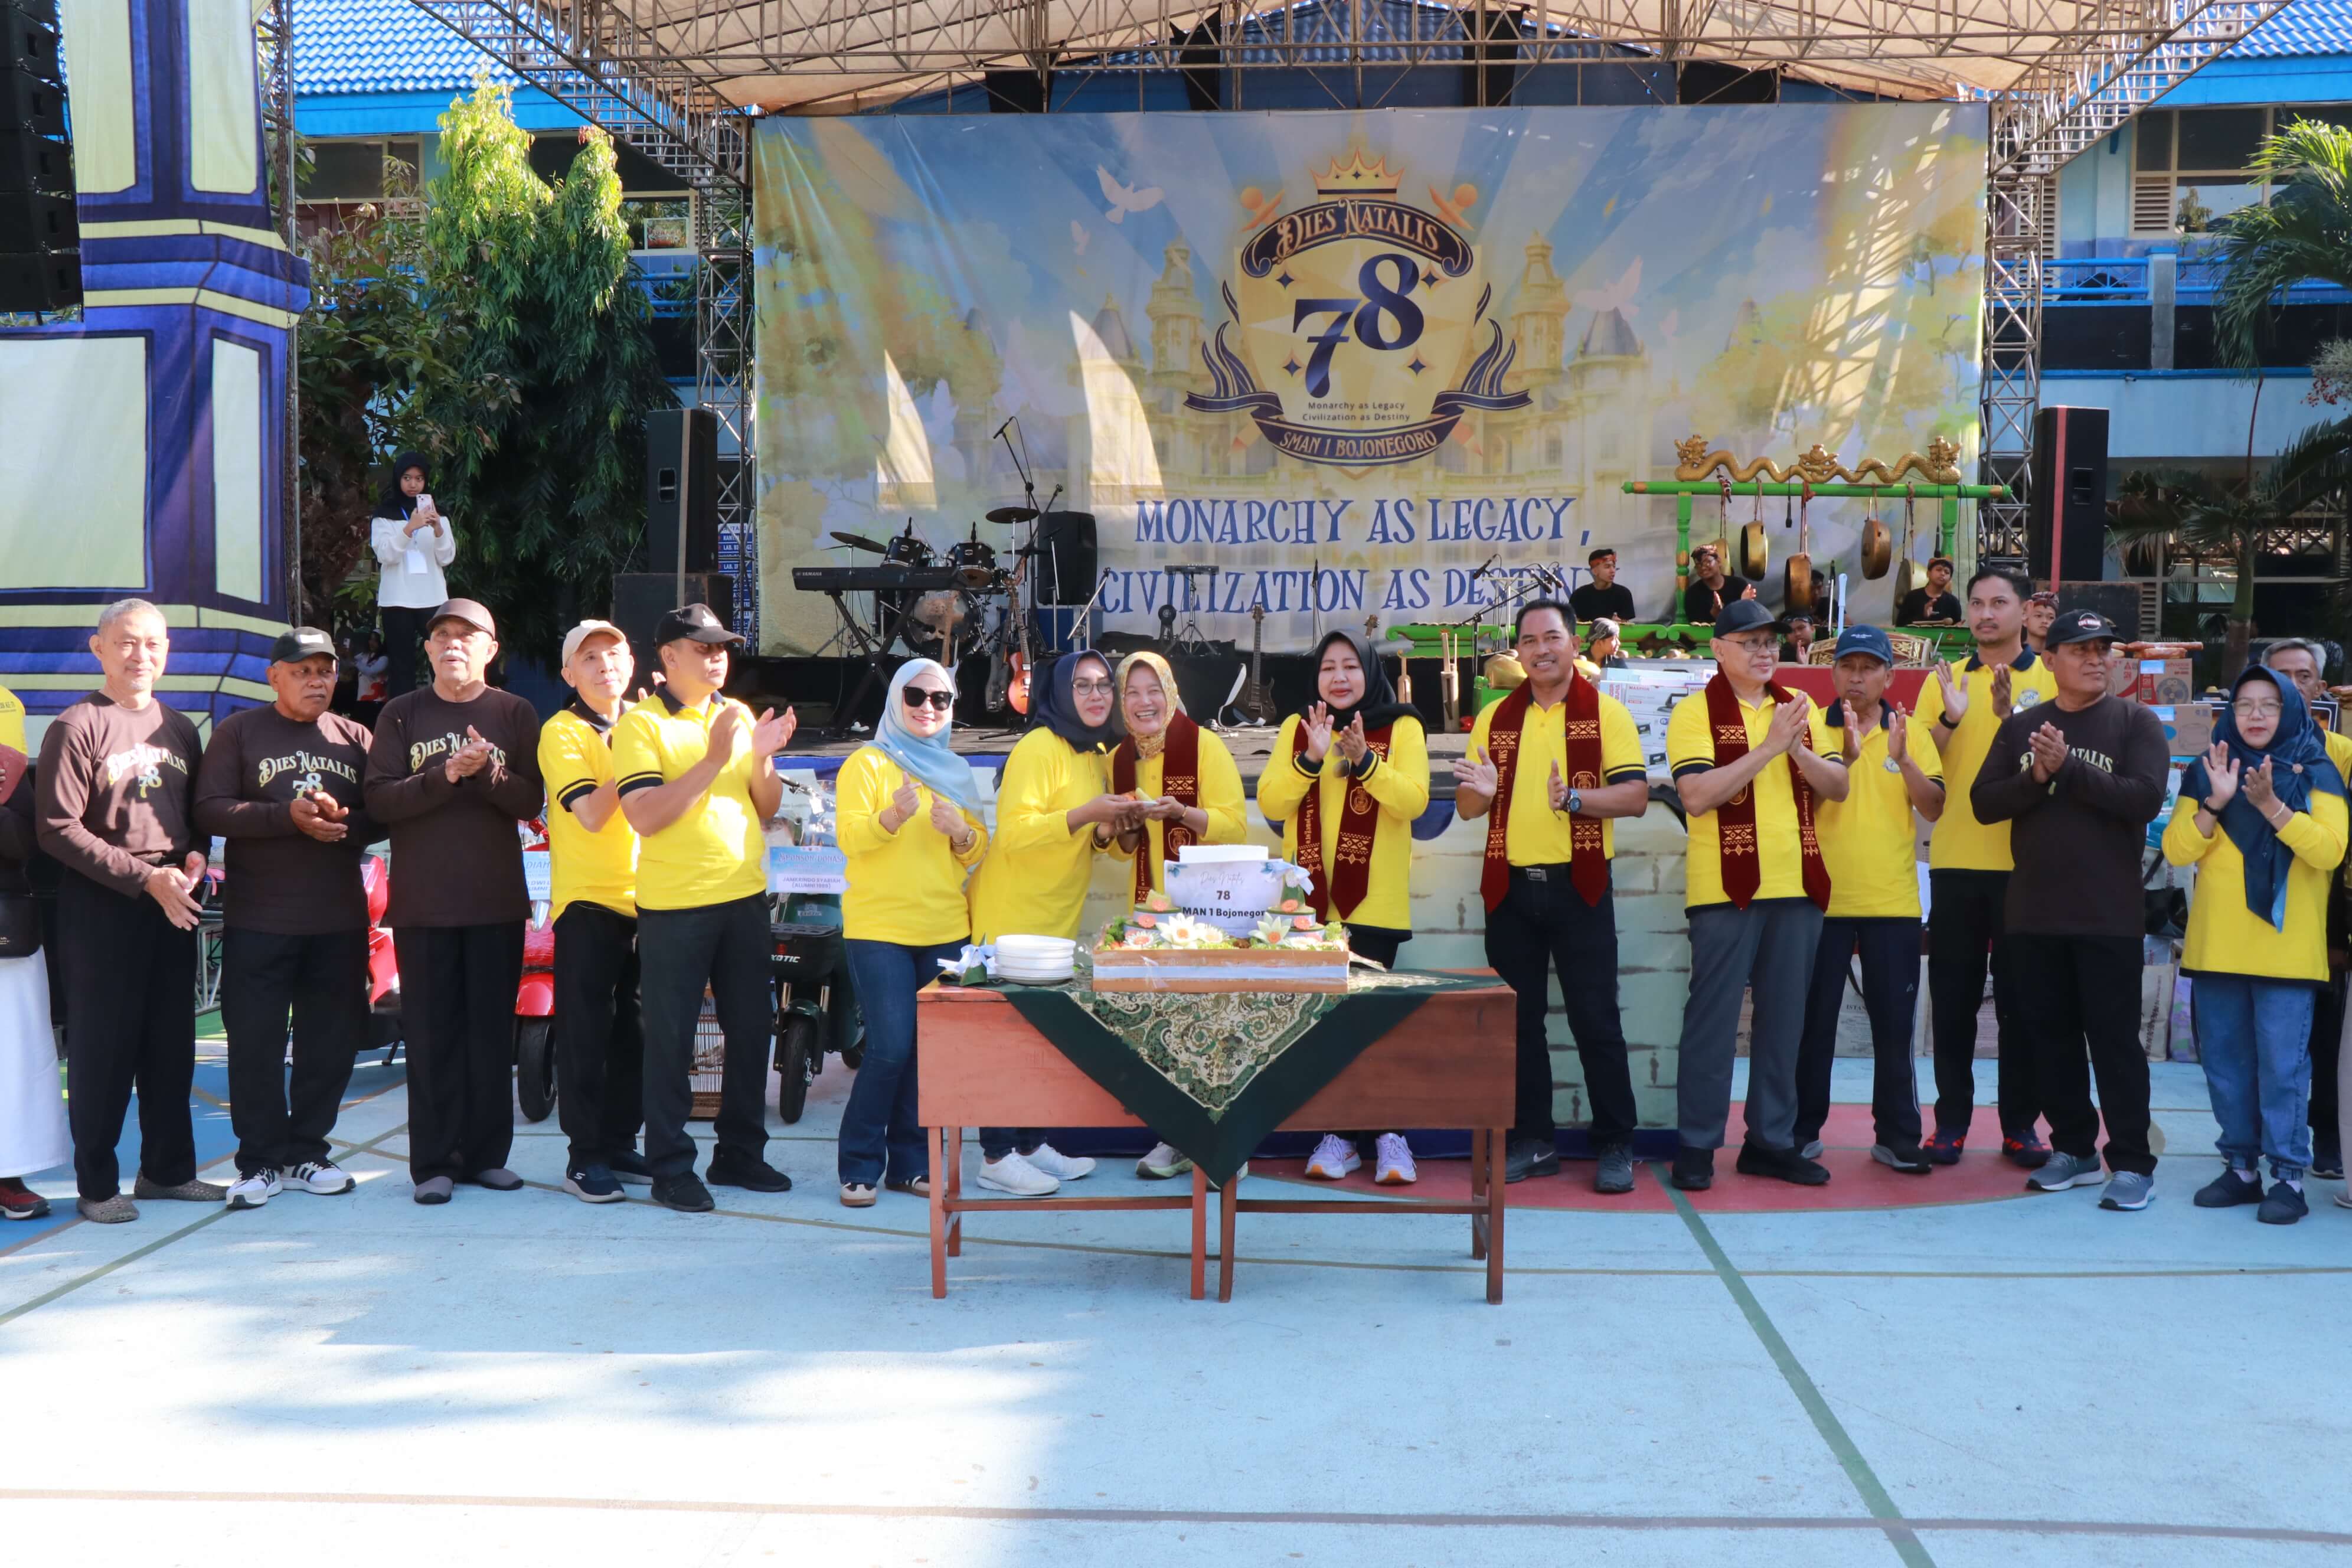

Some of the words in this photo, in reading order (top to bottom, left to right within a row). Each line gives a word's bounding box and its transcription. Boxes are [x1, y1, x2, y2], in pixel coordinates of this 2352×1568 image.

[1292, 254, 1424, 398] 78
[1308, 402, 1355, 411] Monarchy
[1373, 402, 1405, 411] Legacy
[1374, 413, 1410, 422] Destiny
[1279, 431, 1322, 454] SMAN
[1324, 437, 1331, 456] 1
[1335, 429, 1438, 458] BOJONEGORO
[1135, 499, 1354, 545] MONARCHY
[1366, 498, 1416, 545] AS
[1427, 498, 1577, 543] LEGACY
[1096, 569, 1370, 615] CIVILIZATION
[1381, 569, 1431, 612] AS
[259, 756, 297, 788] DIES
[296, 750, 357, 784] NATALIS
[1498, 749, 1508, 763] SMA
[2066, 744, 2113, 773] ATALIS
[138, 765, 162, 799] 78
[1216, 890, 1231, 900] 78
[1182, 907, 1207, 916] MAN
[1216, 909, 1265, 919] Bojonegor
[771, 954, 801, 963] XOTIC
